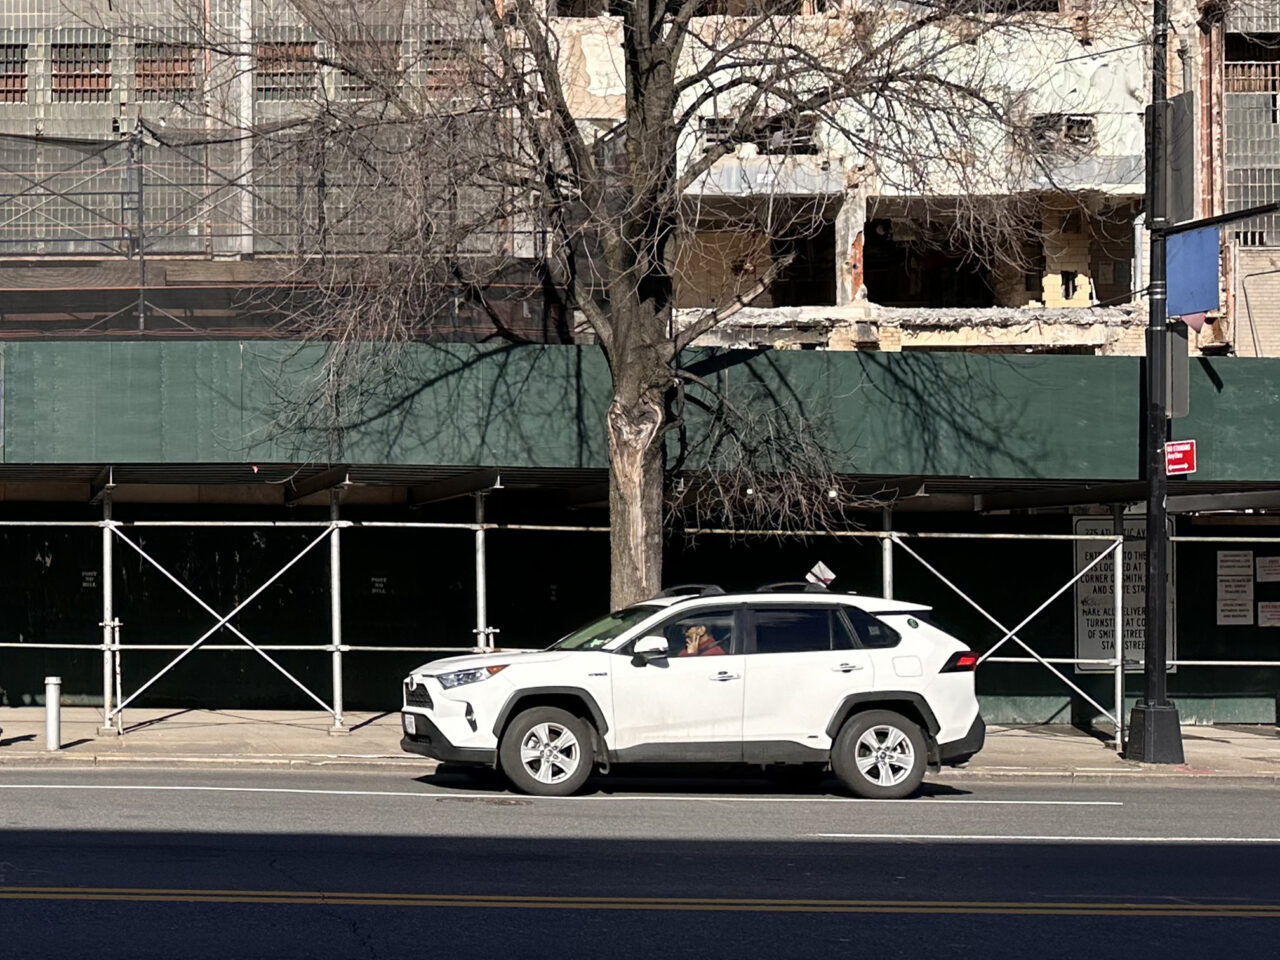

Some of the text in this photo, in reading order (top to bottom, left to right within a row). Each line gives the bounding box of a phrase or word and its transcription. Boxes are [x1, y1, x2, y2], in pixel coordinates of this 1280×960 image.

[1085, 551, 1115, 563] ENTRAN
[1100, 563, 1131, 572] LOCED
[1133, 563, 1142, 572] AT
[1080, 574, 1108, 583] CORNER
[1122, 574, 1143, 583] SMITH
[1093, 585, 1106, 594] AND
[1086, 618, 1115, 627] TURNSTI
[1125, 618, 1134, 627] AT
[1087, 629, 1096, 639] OF
[1098, 629, 1115, 639] SMIT
[1102, 640, 1146, 650] STA STREE
